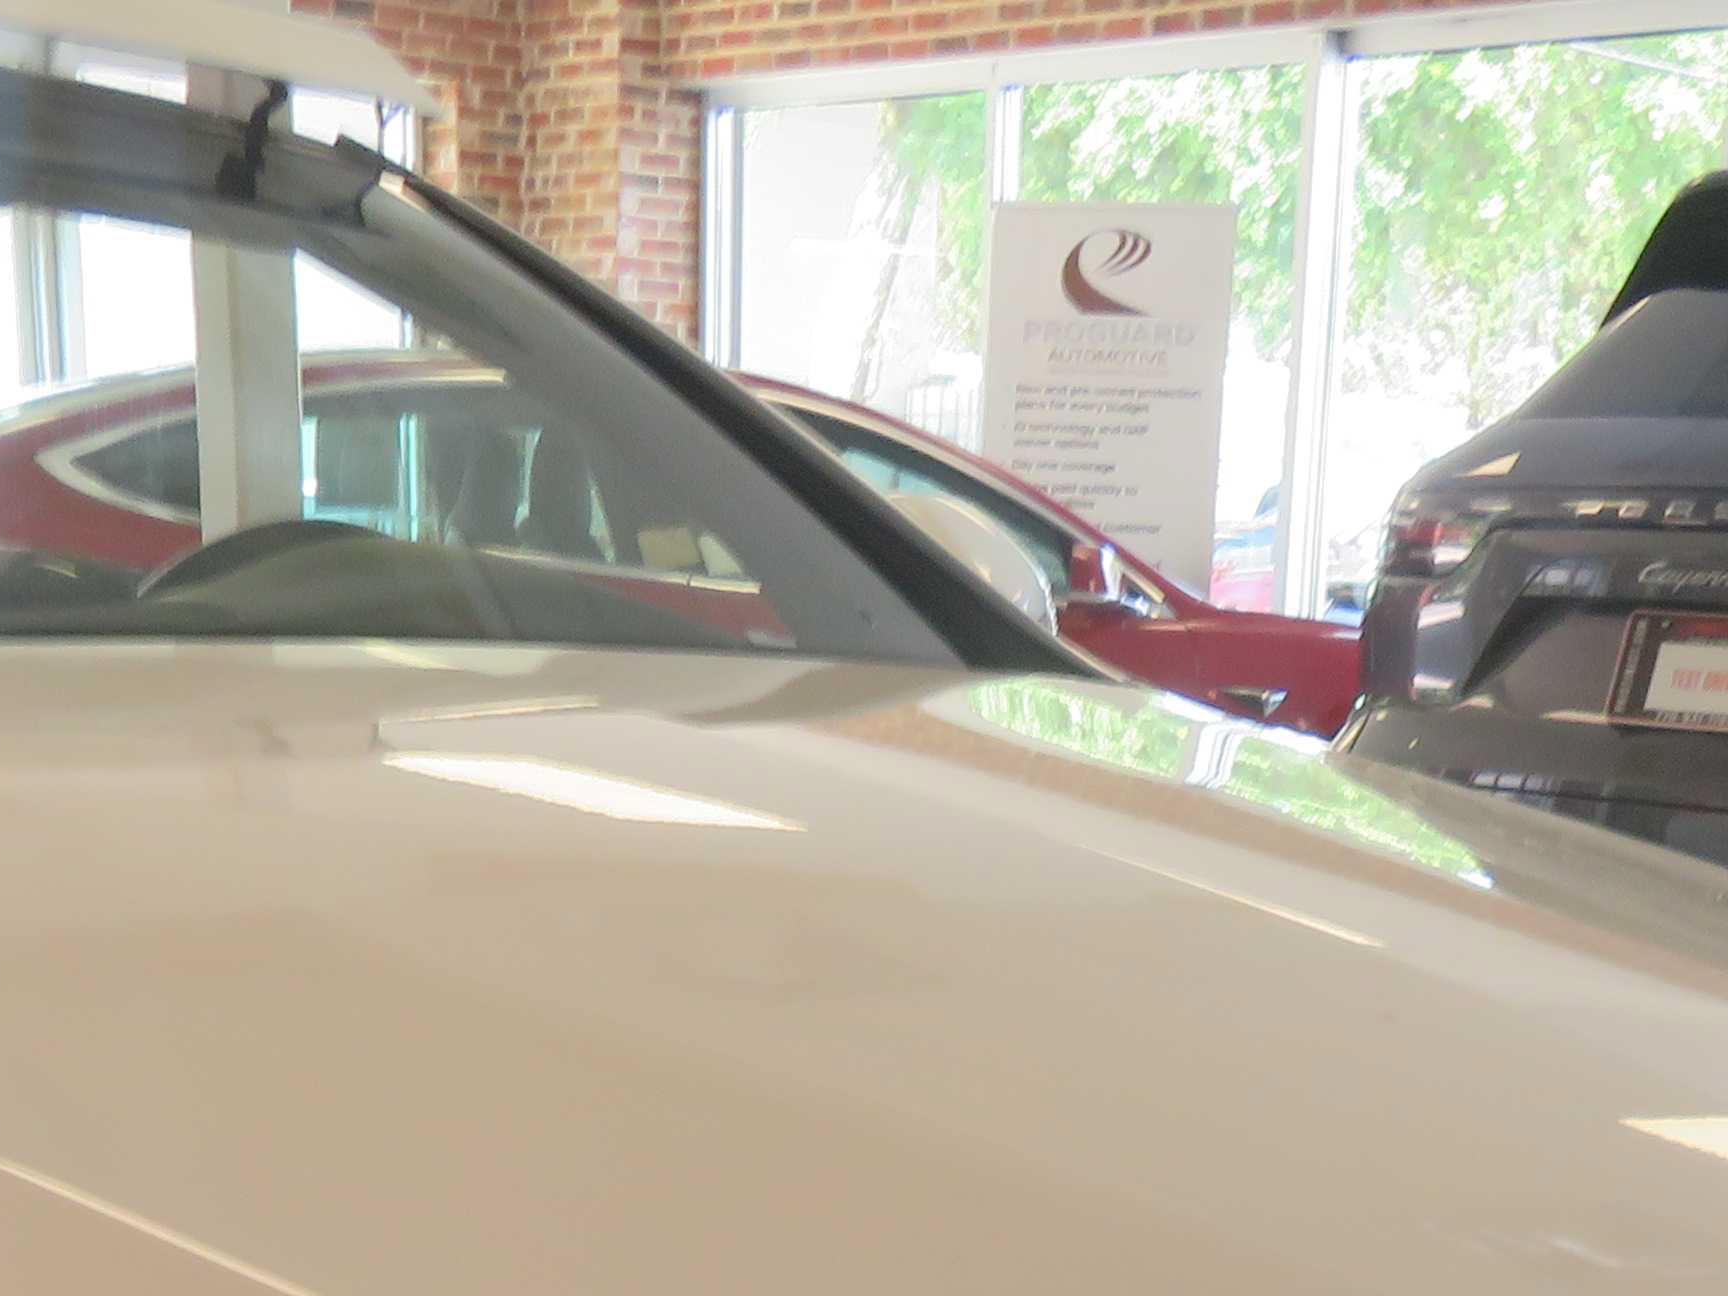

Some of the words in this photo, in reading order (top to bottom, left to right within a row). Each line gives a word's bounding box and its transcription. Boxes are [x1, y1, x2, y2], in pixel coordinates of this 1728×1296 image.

[1022, 319, 1200, 347] PROGUARD
[1047, 347, 1168, 366] AUTOMOTIVE
[1061, 462, 1116, 474] coverage
